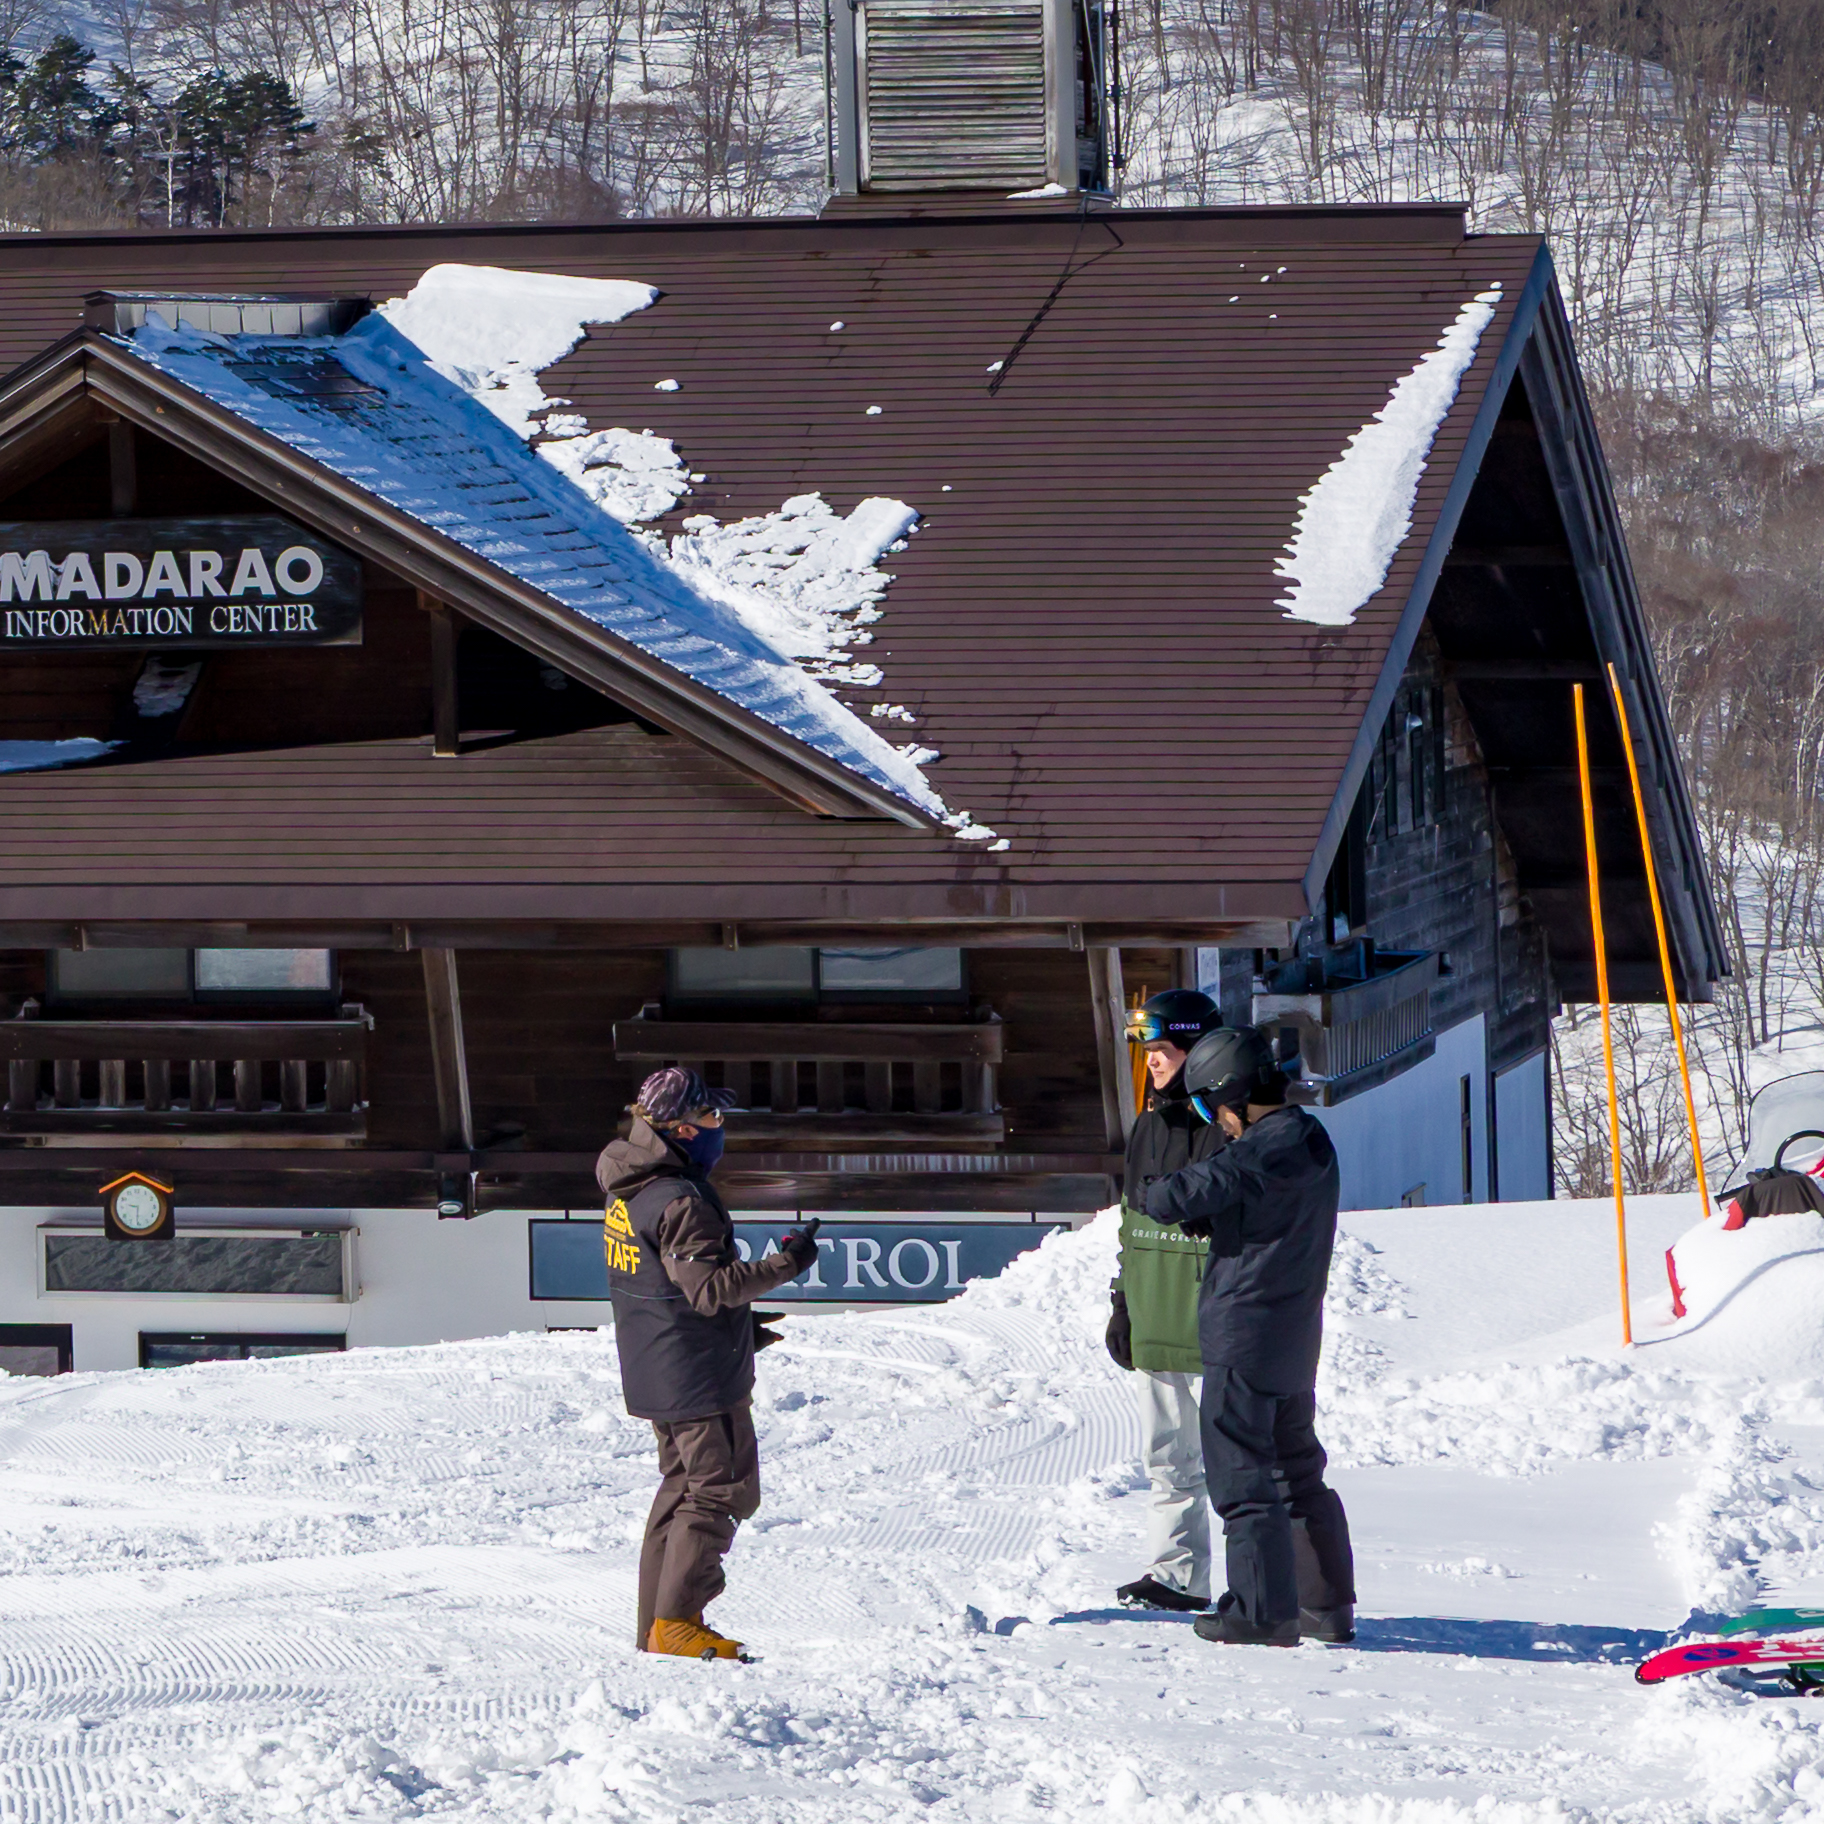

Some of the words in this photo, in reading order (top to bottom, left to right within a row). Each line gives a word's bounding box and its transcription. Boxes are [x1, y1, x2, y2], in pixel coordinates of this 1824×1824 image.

[0, 546, 324, 602] MADARAO
[4, 606, 195, 638] INFORMATION
[209, 603, 319, 633] CENTER
[1168, 1022, 1201, 1031] CORVAS
[604, 1234, 640, 1275] TAFF
